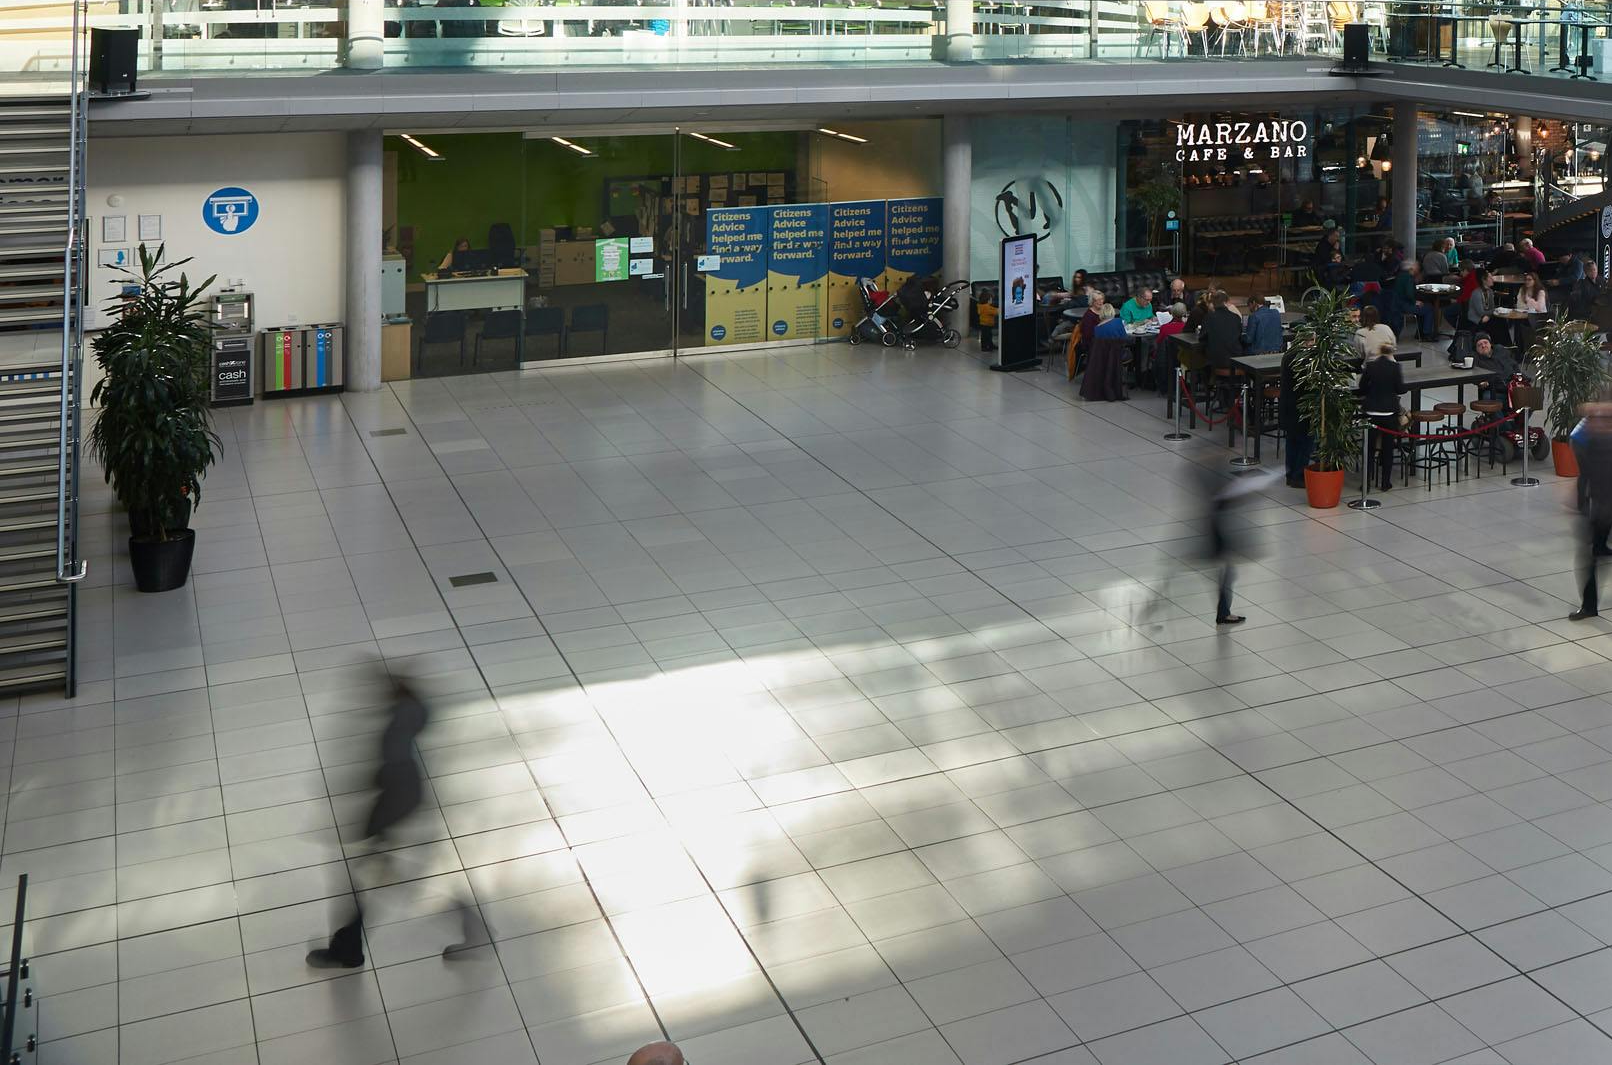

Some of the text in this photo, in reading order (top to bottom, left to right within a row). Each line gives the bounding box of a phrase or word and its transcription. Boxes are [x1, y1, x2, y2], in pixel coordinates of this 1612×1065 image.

[1176, 119, 1308, 146] MARZANO
[1175, 144, 1308, 162] CAFE & BAR
[773, 209, 812, 218] Citizens
[834, 207, 871, 217] Citizens
[891, 205, 929, 214] Citizens
[712, 213, 751, 222] Citizens
[834, 218, 865, 227] Advice
[891, 215, 924, 224] Advice
[712, 222, 745, 232] Advice
[773, 220, 807, 229] Advice
[773, 229, 824, 240] helped me
[833, 229, 883, 240] helped me
[891, 225, 940, 235] helped me
[712, 233, 763, 244] helped me
[712, 245, 732, 254] find
[833, 240, 852, 249] find
[862, 240, 882, 249] way
[773, 251, 815, 261] forward.
[833, 250, 875, 260] forward.
[891, 246, 932, 256] forward.
[719, 254, 754, 264] orward.
[219, 369, 246, 380] cash
